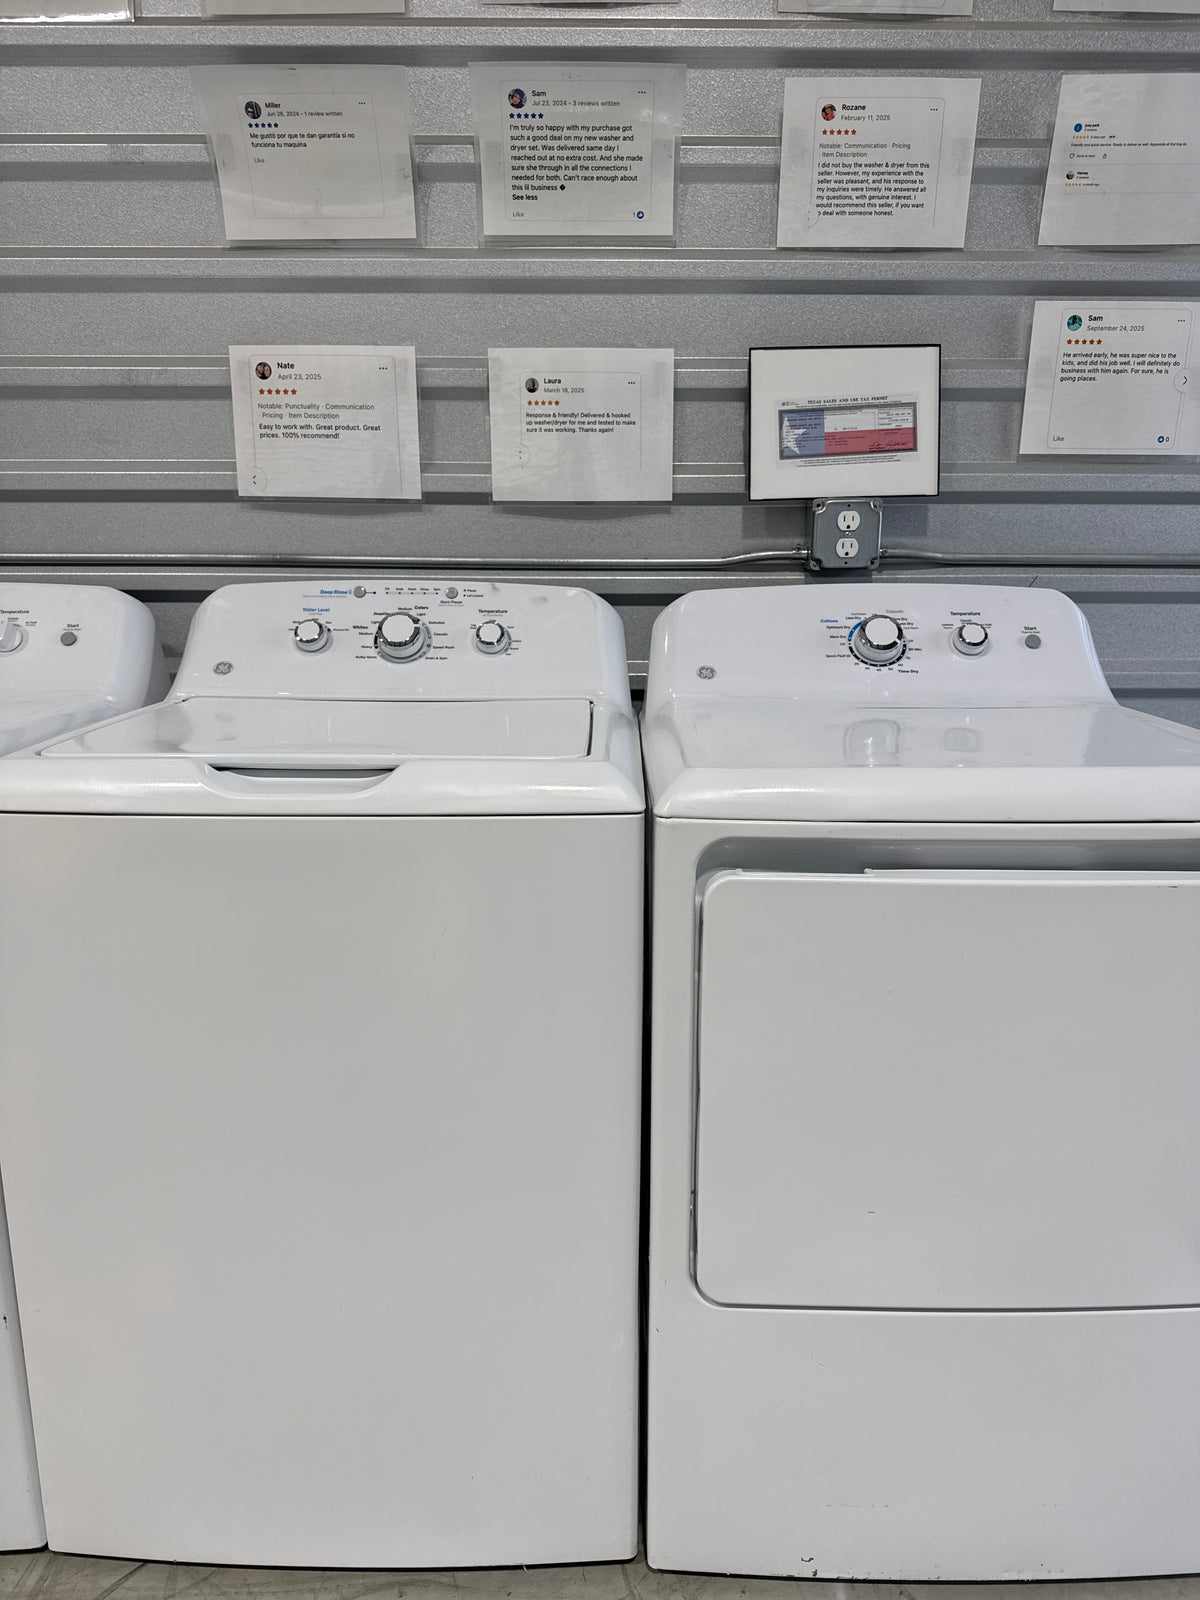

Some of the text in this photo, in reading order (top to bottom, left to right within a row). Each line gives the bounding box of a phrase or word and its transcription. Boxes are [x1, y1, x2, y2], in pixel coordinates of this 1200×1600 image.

[622, 125, 632, 133] got
[573, 135, 583, 143] my
[285, 403, 320, 411] Punctuality
[262, 412, 284, 420] Pricing
[303, 412, 340, 420] Description
[259, 423, 274, 431] Easy
